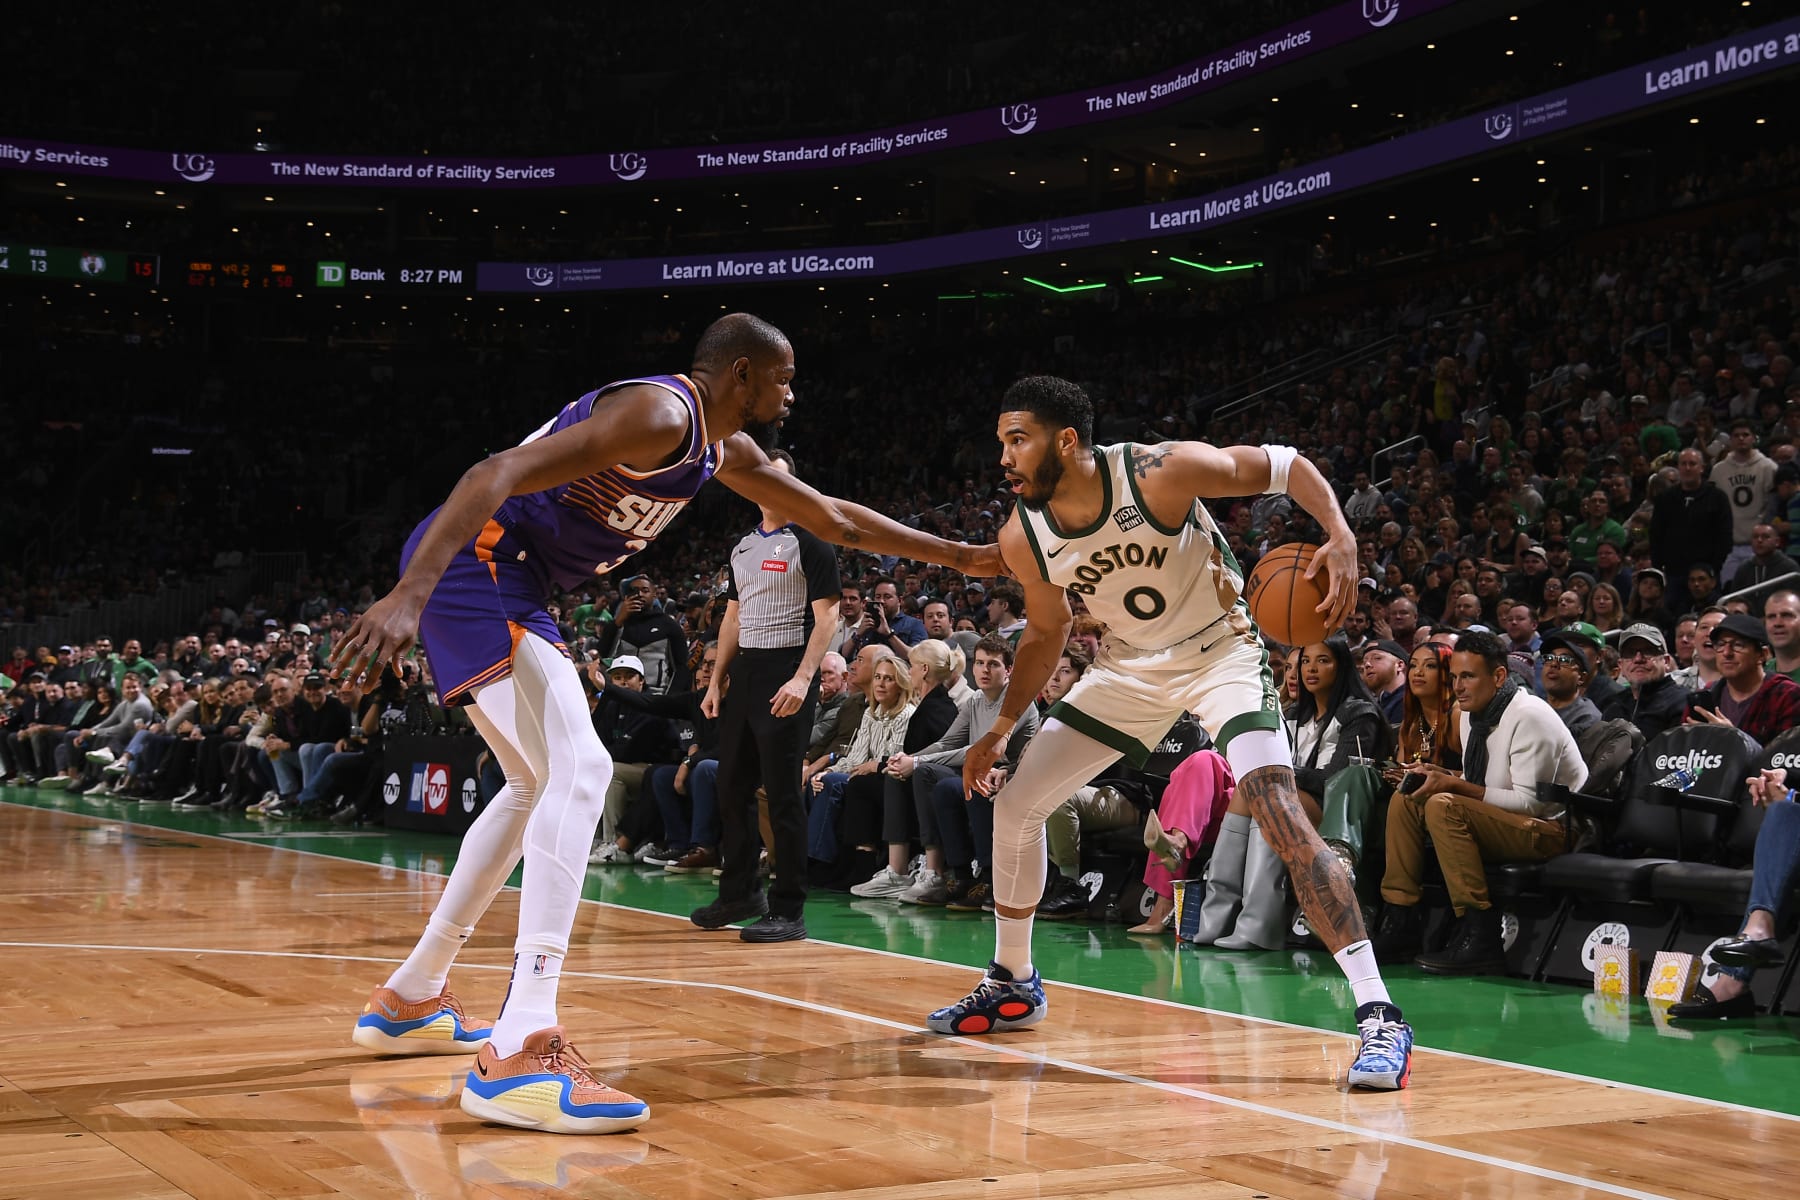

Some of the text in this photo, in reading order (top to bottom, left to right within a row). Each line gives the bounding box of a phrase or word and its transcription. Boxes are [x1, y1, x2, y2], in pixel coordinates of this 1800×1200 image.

[1086, 30, 1311, 112] The New Standard of Facility Services
[1645, 32, 1800, 95] Learn More a
[1002, 104, 1038, 125] UG2
[34, 148, 109, 168] Services
[697, 128, 948, 168] The New Standard of Facility Services
[172, 153, 215, 173] UG2
[271, 162, 555, 183] The New Standard of Facility Services
[610, 153, 648, 174] UG2
[1149, 171, 1331, 230] Learn More at UG2.com
[1017, 228, 1042, 243] UG2
[31, 259, 48, 273] 13
[133, 261, 153, 277] 15
[320, 266, 386, 282] TD Bank
[400, 269, 463, 284] 8:27 PM
[526, 267, 553, 281] UG2
[662, 255, 874, 280] Learn More at UG2.com
[1733, 486, 1753, 507] 0
[1114, 507, 1139, 524] VISTA
[1120, 514, 1143, 531] PRINT
[1068, 542, 1169, 596] BOSTON
[1123, 586, 1166, 620] 0
[1655, 749, 1723, 770] @celtics
